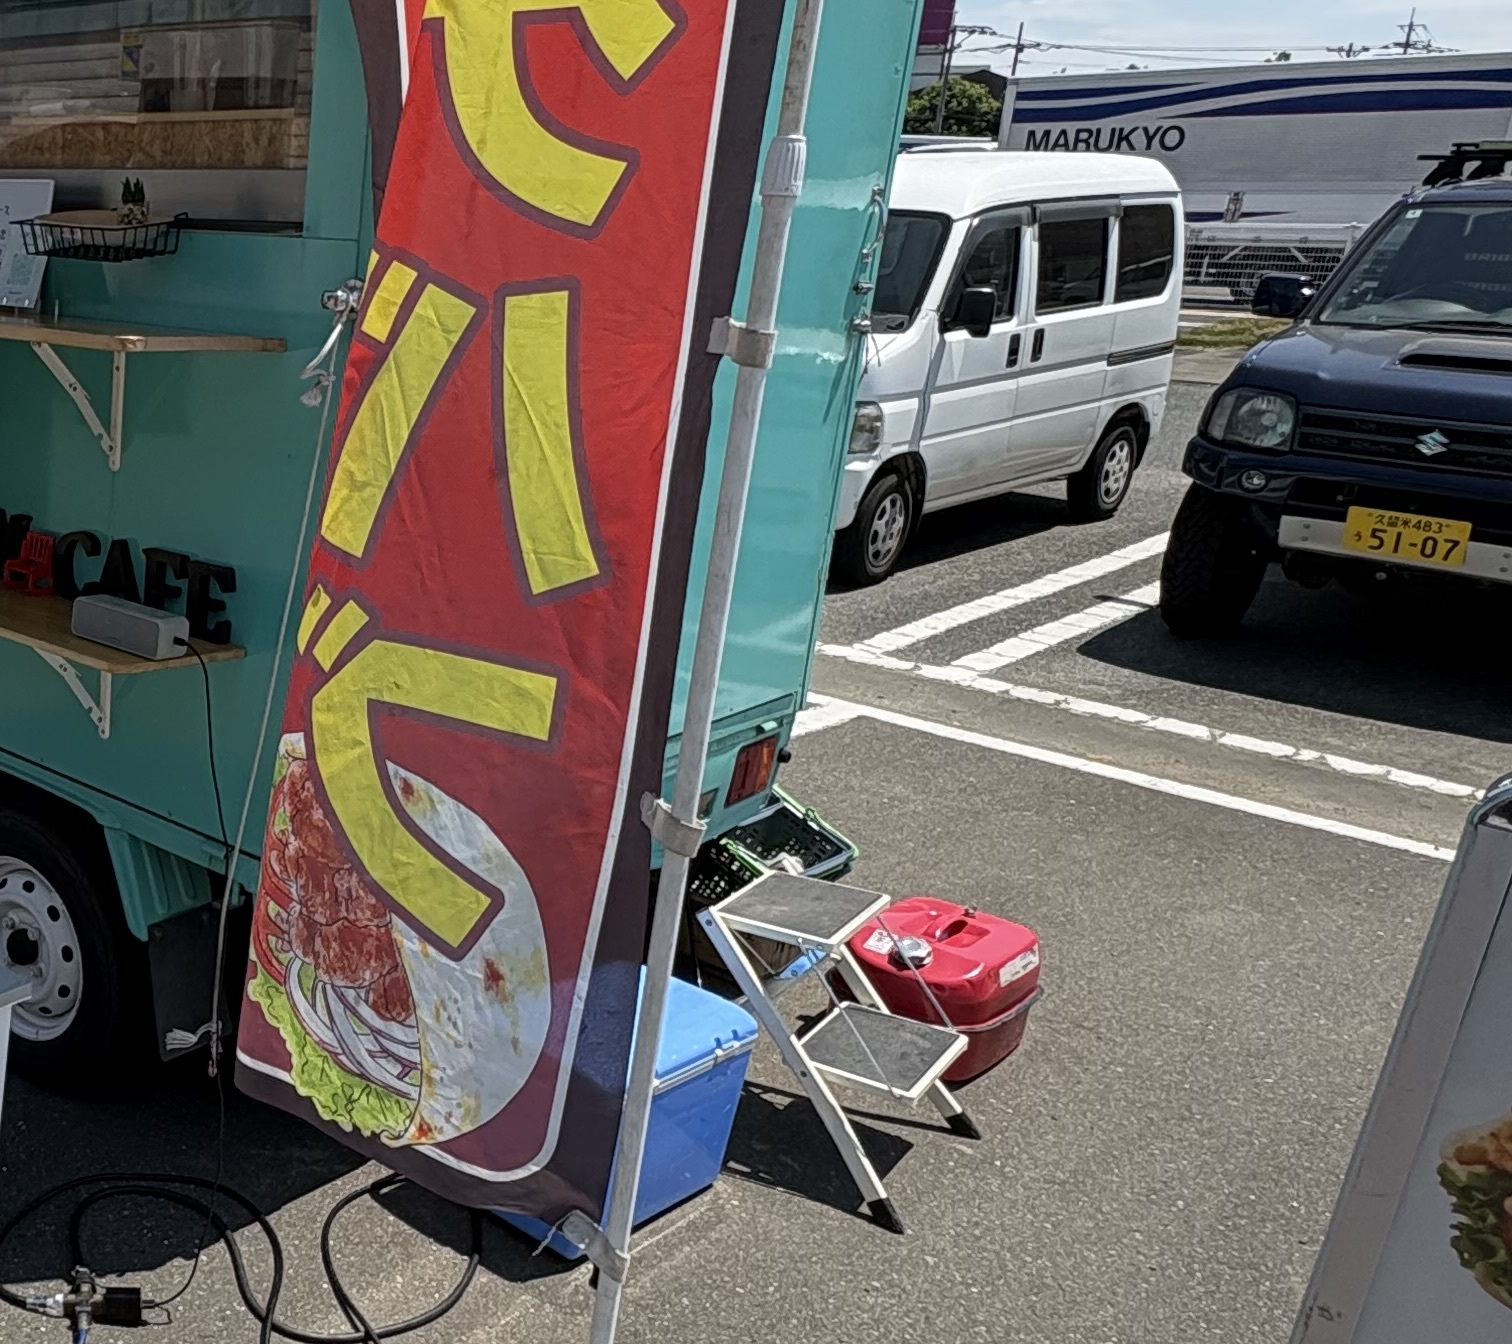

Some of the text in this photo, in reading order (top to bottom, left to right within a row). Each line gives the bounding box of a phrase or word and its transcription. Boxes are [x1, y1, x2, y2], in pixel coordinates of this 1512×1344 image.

[1024, 125, 1186, 153] MARUKYO
[1412, 519, 1444, 534] 483
[1367, 527, 1461, 562] 51-07
[54, 531, 237, 645] CAFE
